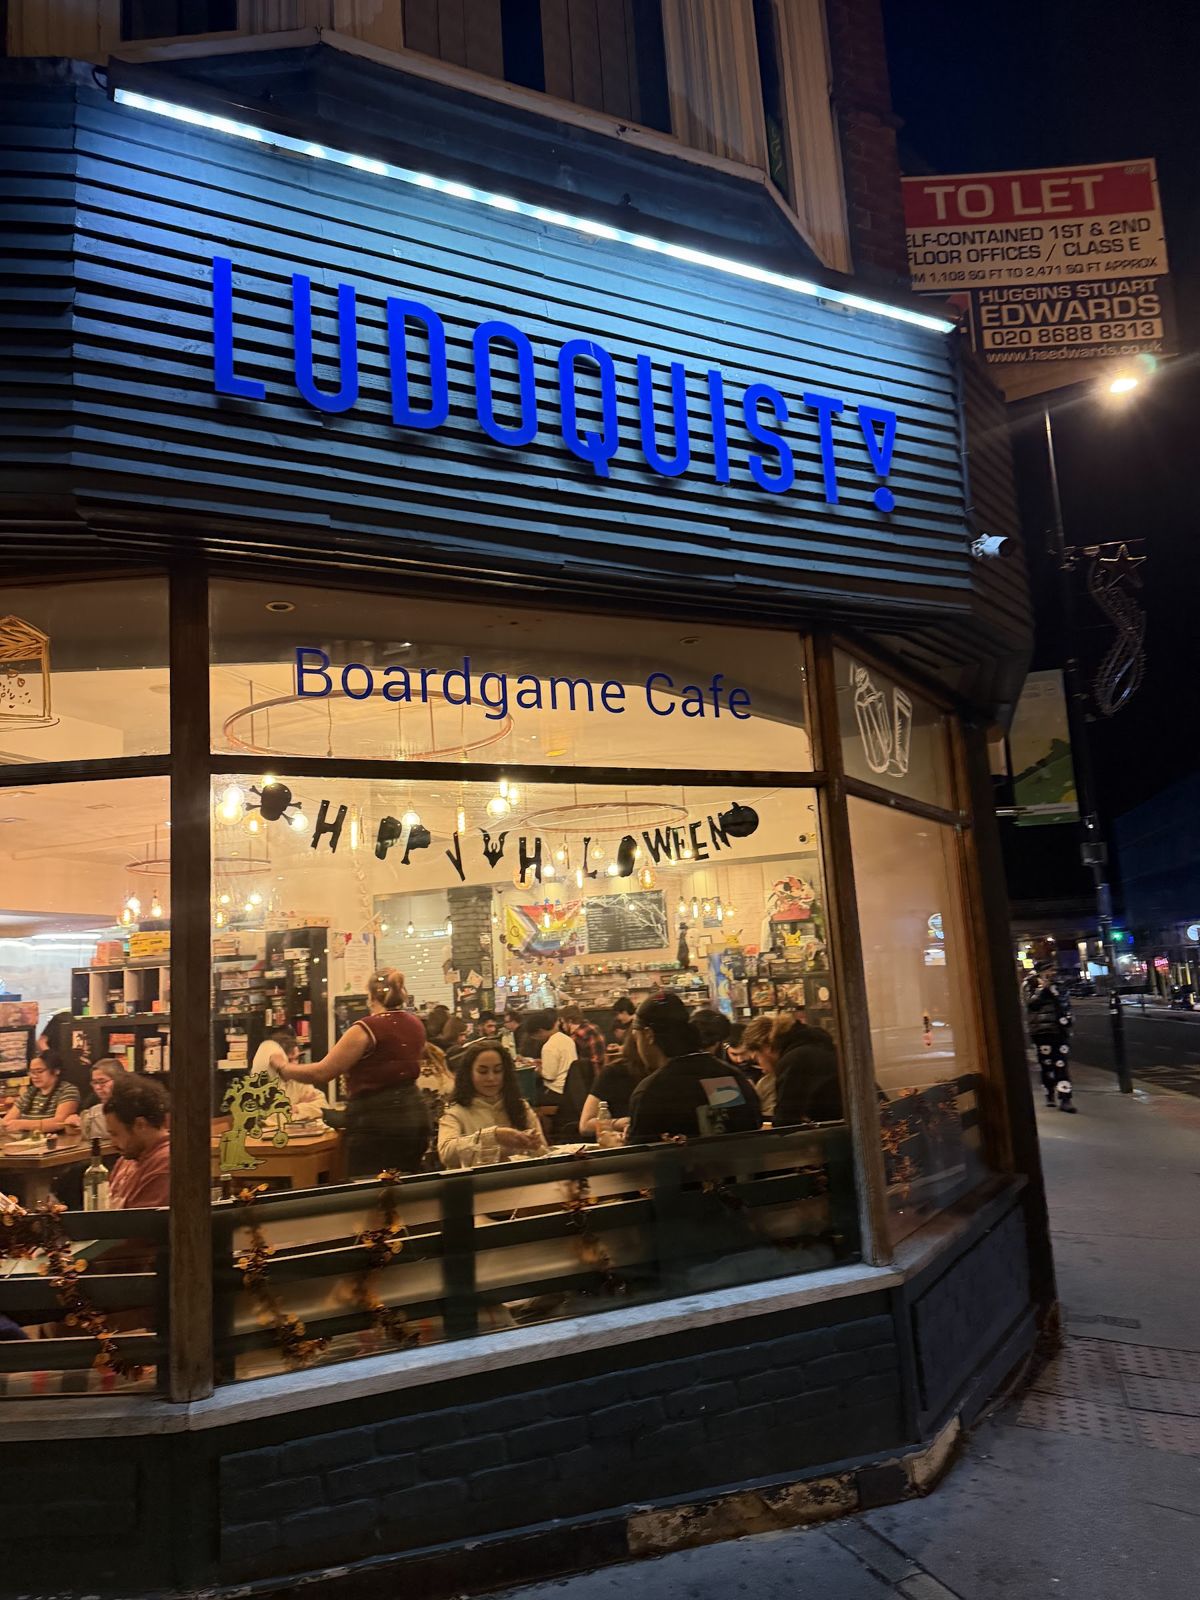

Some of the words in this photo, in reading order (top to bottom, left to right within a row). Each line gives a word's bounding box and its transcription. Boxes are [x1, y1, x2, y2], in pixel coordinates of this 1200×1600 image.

[924, 184, 994, 219] TO
[1011, 175, 1104, 215] LET
[906, 227, 1043, 248] ELF-CONTAINED
[1049, 224, 1084, 239] 1ST
[1090, 222, 1104, 237] &
[1109, 218, 1151, 235] 2ND
[967, 245, 1040, 262] OFFICES
[1046, 243, 1056, 262] /
[1064, 239, 1124, 257] CLASS
[1130, 237, 1141, 251] E
[969, 269, 986, 280] SQ
[989, 269, 1004, 279] FT
[1005, 268, 1023, 278] TO
[1025, 265, 1061, 279] 2,471
[1066, 263, 1084, 274] SQ
[1087, 262, 1101, 272] FT
[1104, 256, 1158, 271] APPROX
[980, 285, 1071, 303] HUGGINS
[1077, 278, 1158, 297] STUART
[981, 294, 1161, 326] EDWARDS
[992, 330, 1031, 346] 020
[1038, 326, 1092, 343] 8688
[1099, 321, 1154, 340] 8313
[295, 646, 626, 719] Boardgame
[645, 672, 752, 720] Cafe
